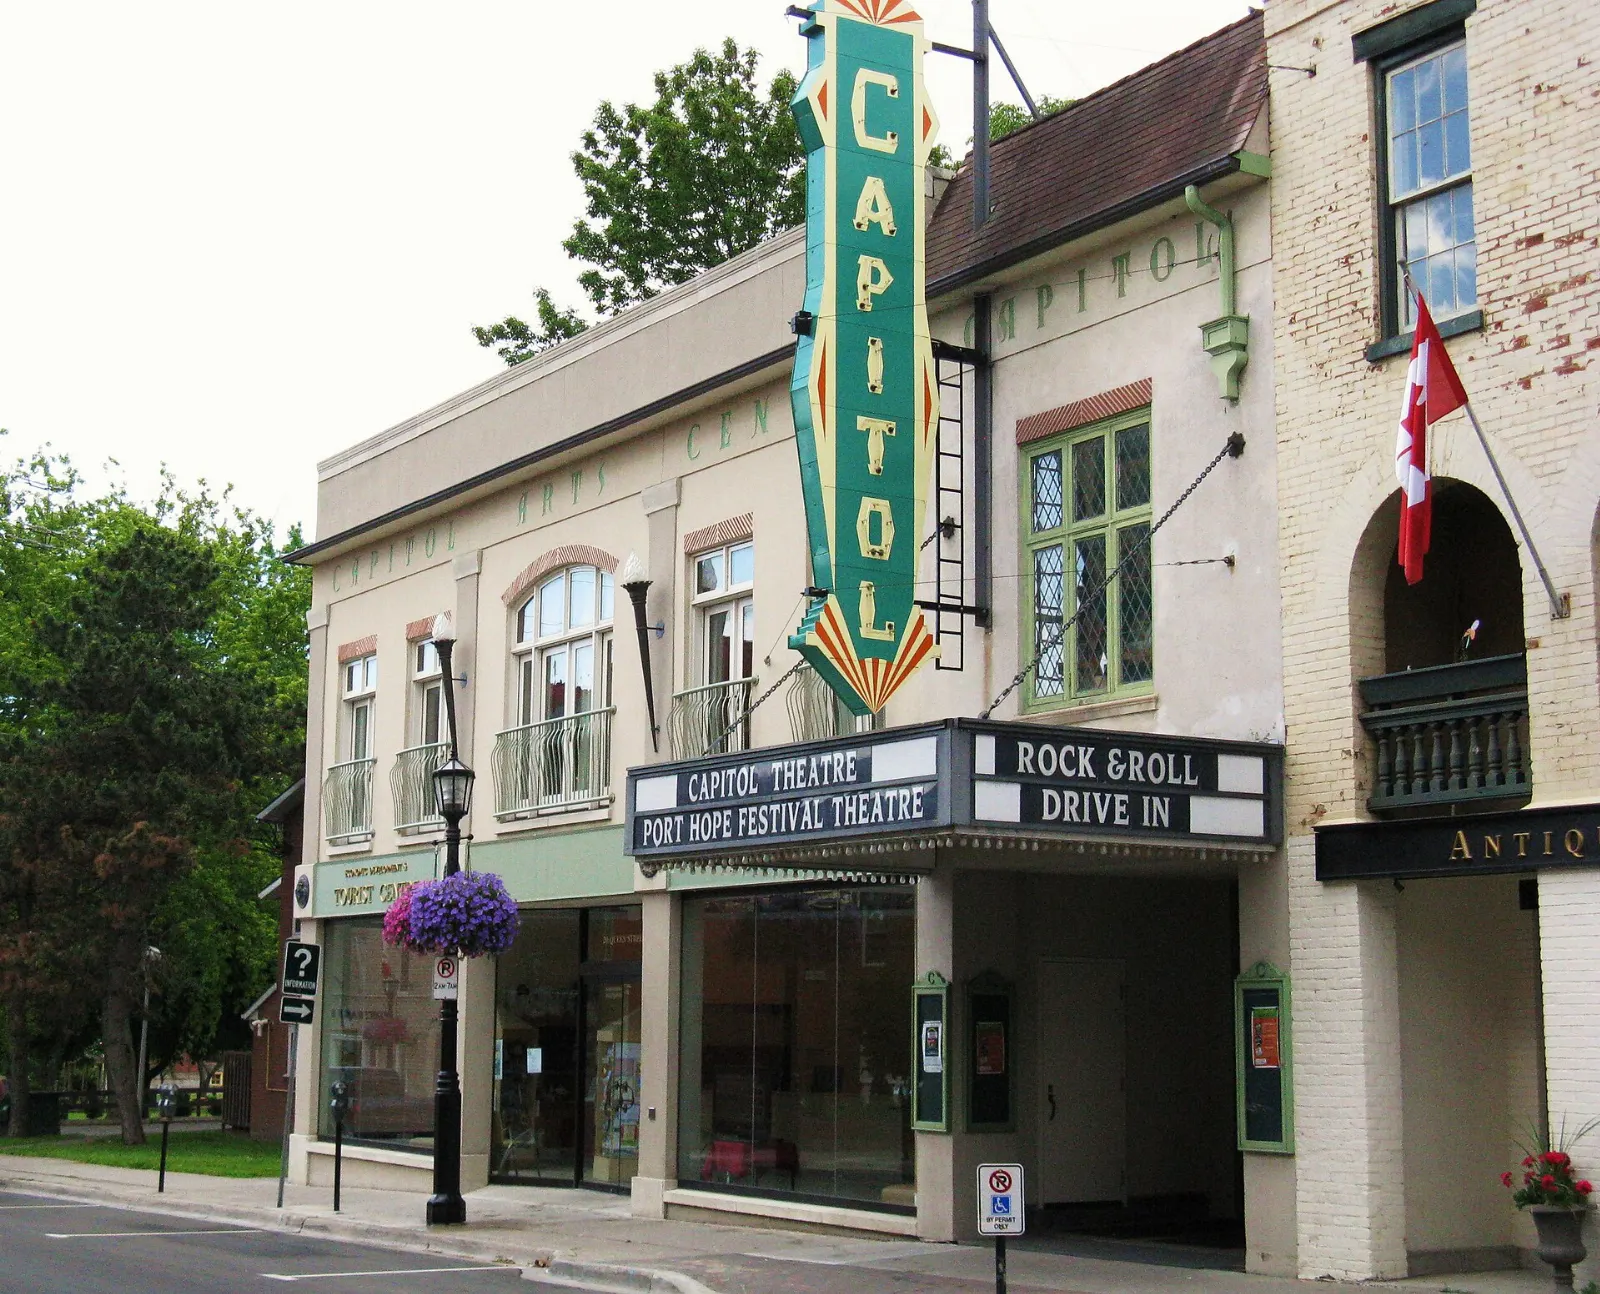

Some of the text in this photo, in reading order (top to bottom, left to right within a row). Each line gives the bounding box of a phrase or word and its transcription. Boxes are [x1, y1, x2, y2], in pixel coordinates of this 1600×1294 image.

[850, 67, 901, 644] CAPITOL
[332, 520, 457, 593] CAPITOL
[515, 462, 607, 526] ARTS
[688, 750, 858, 802] CAPITOL THEATRE
[1016, 741, 1199, 786] ROCK &ROLL
[643, 786, 925, 848] PORT HOPE FESTIVAL THEATRE
[1041, 788, 1170, 828] DRIVE IN
[1449, 827, 1600, 859] ANTIQ
[334, 886, 374, 906] TOURIST
[284, 979, 316, 990] INFORMATION
